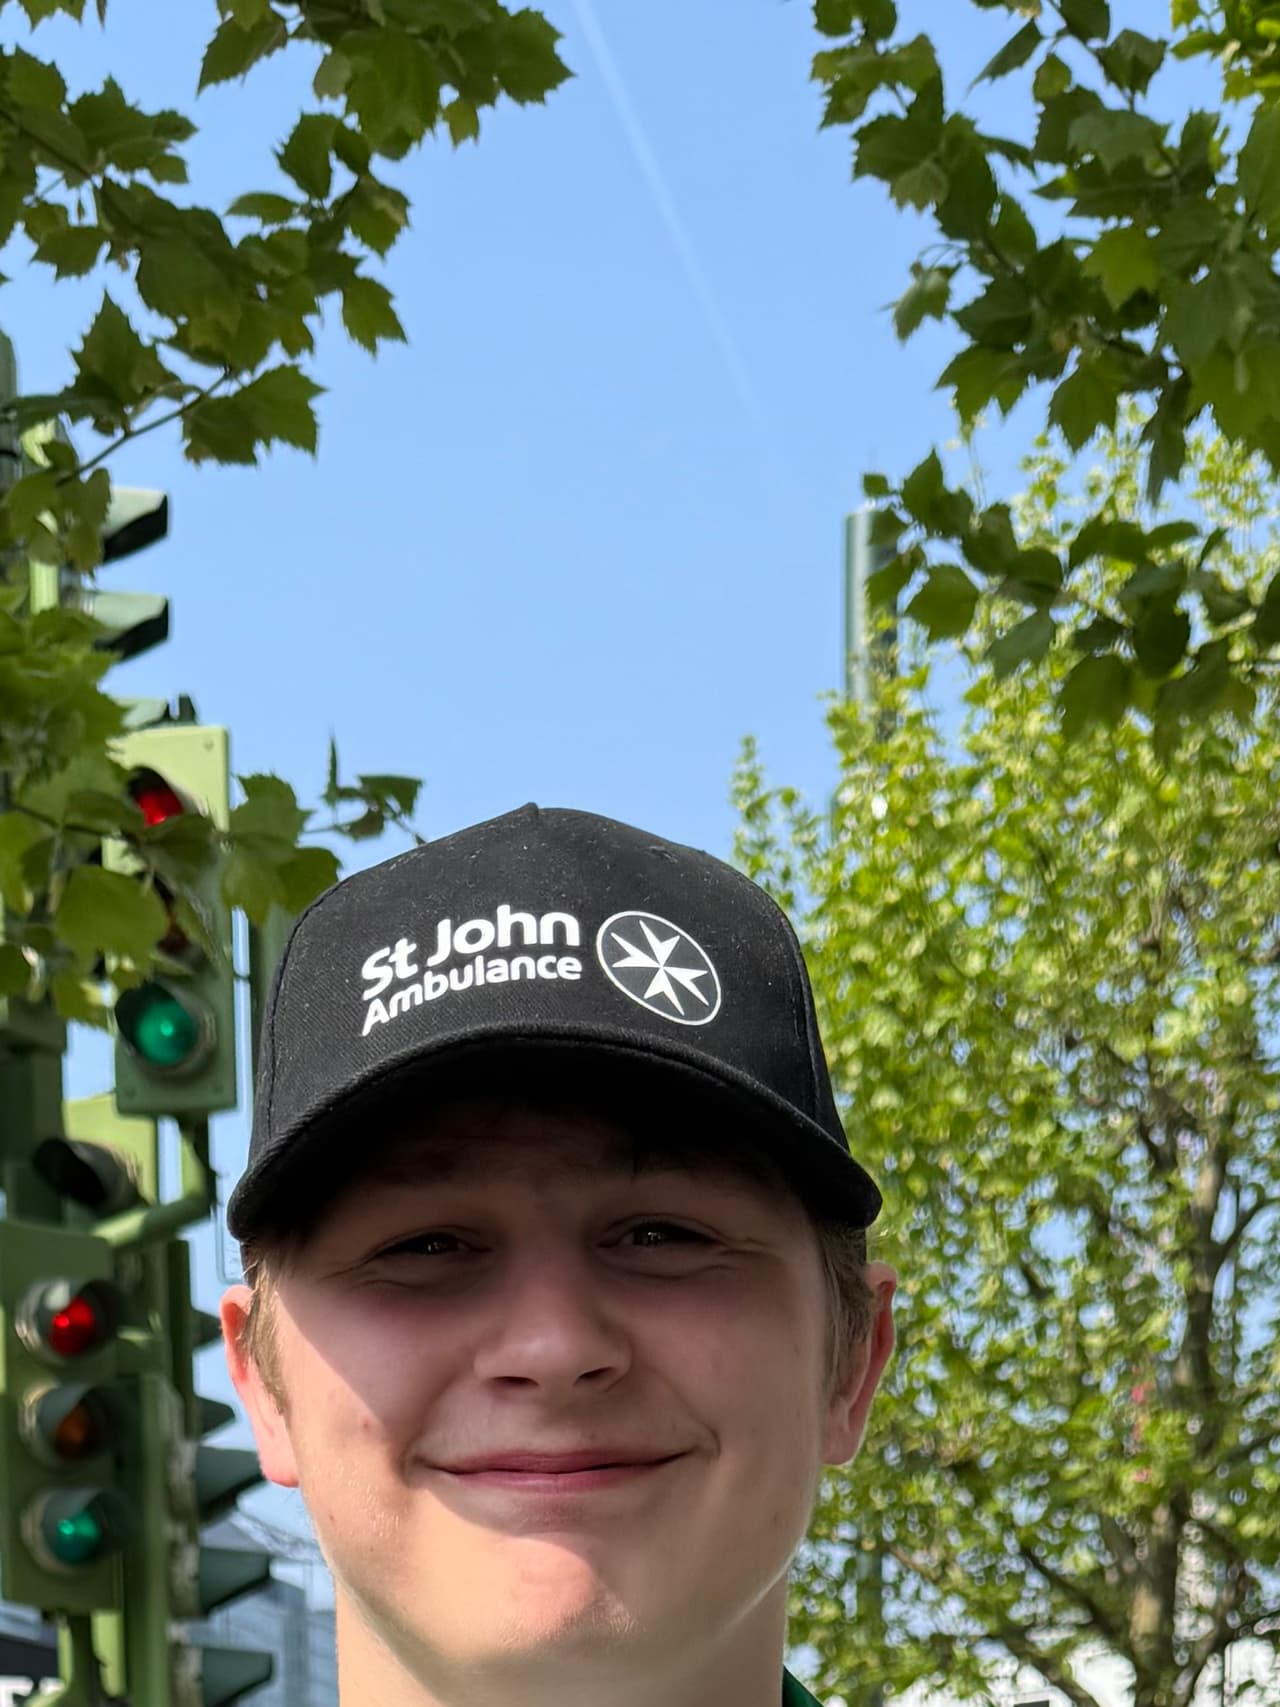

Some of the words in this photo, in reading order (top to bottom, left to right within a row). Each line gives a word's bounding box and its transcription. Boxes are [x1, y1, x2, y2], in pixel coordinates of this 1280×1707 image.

[361, 937, 419, 1000] St
[427, 904, 581, 967] John
[361, 955, 583, 1037] Ambulance
